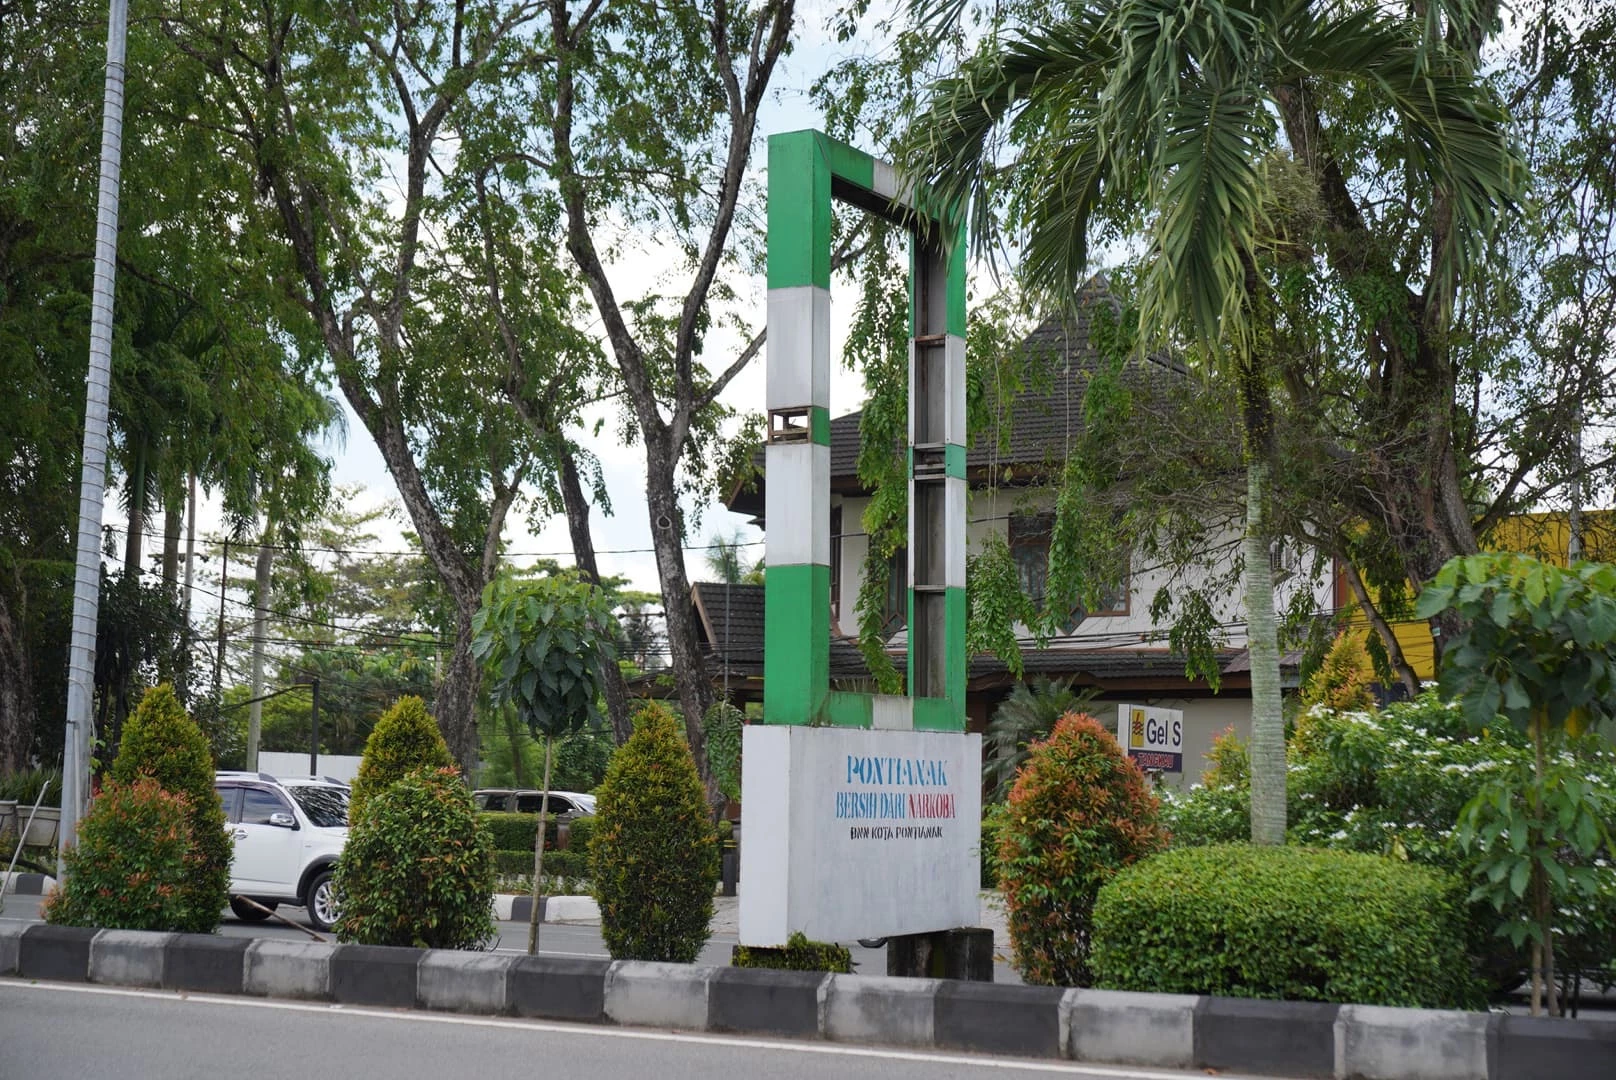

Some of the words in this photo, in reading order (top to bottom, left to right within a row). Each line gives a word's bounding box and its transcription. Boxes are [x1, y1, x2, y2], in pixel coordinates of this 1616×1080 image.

[1147, 718, 1168, 745] Gel
[1173, 721, 1181, 746] S
[847, 755, 947, 786] PONTIANAK
[836, 791, 877, 819] BERSIH
[880, 792, 904, 819] DARI
[908, 793, 956, 819] NARKOBA
[850, 826, 869, 840] BNN
[871, 826, 893, 840] KOTA
[896, 826, 942, 840] PONTIANAK
